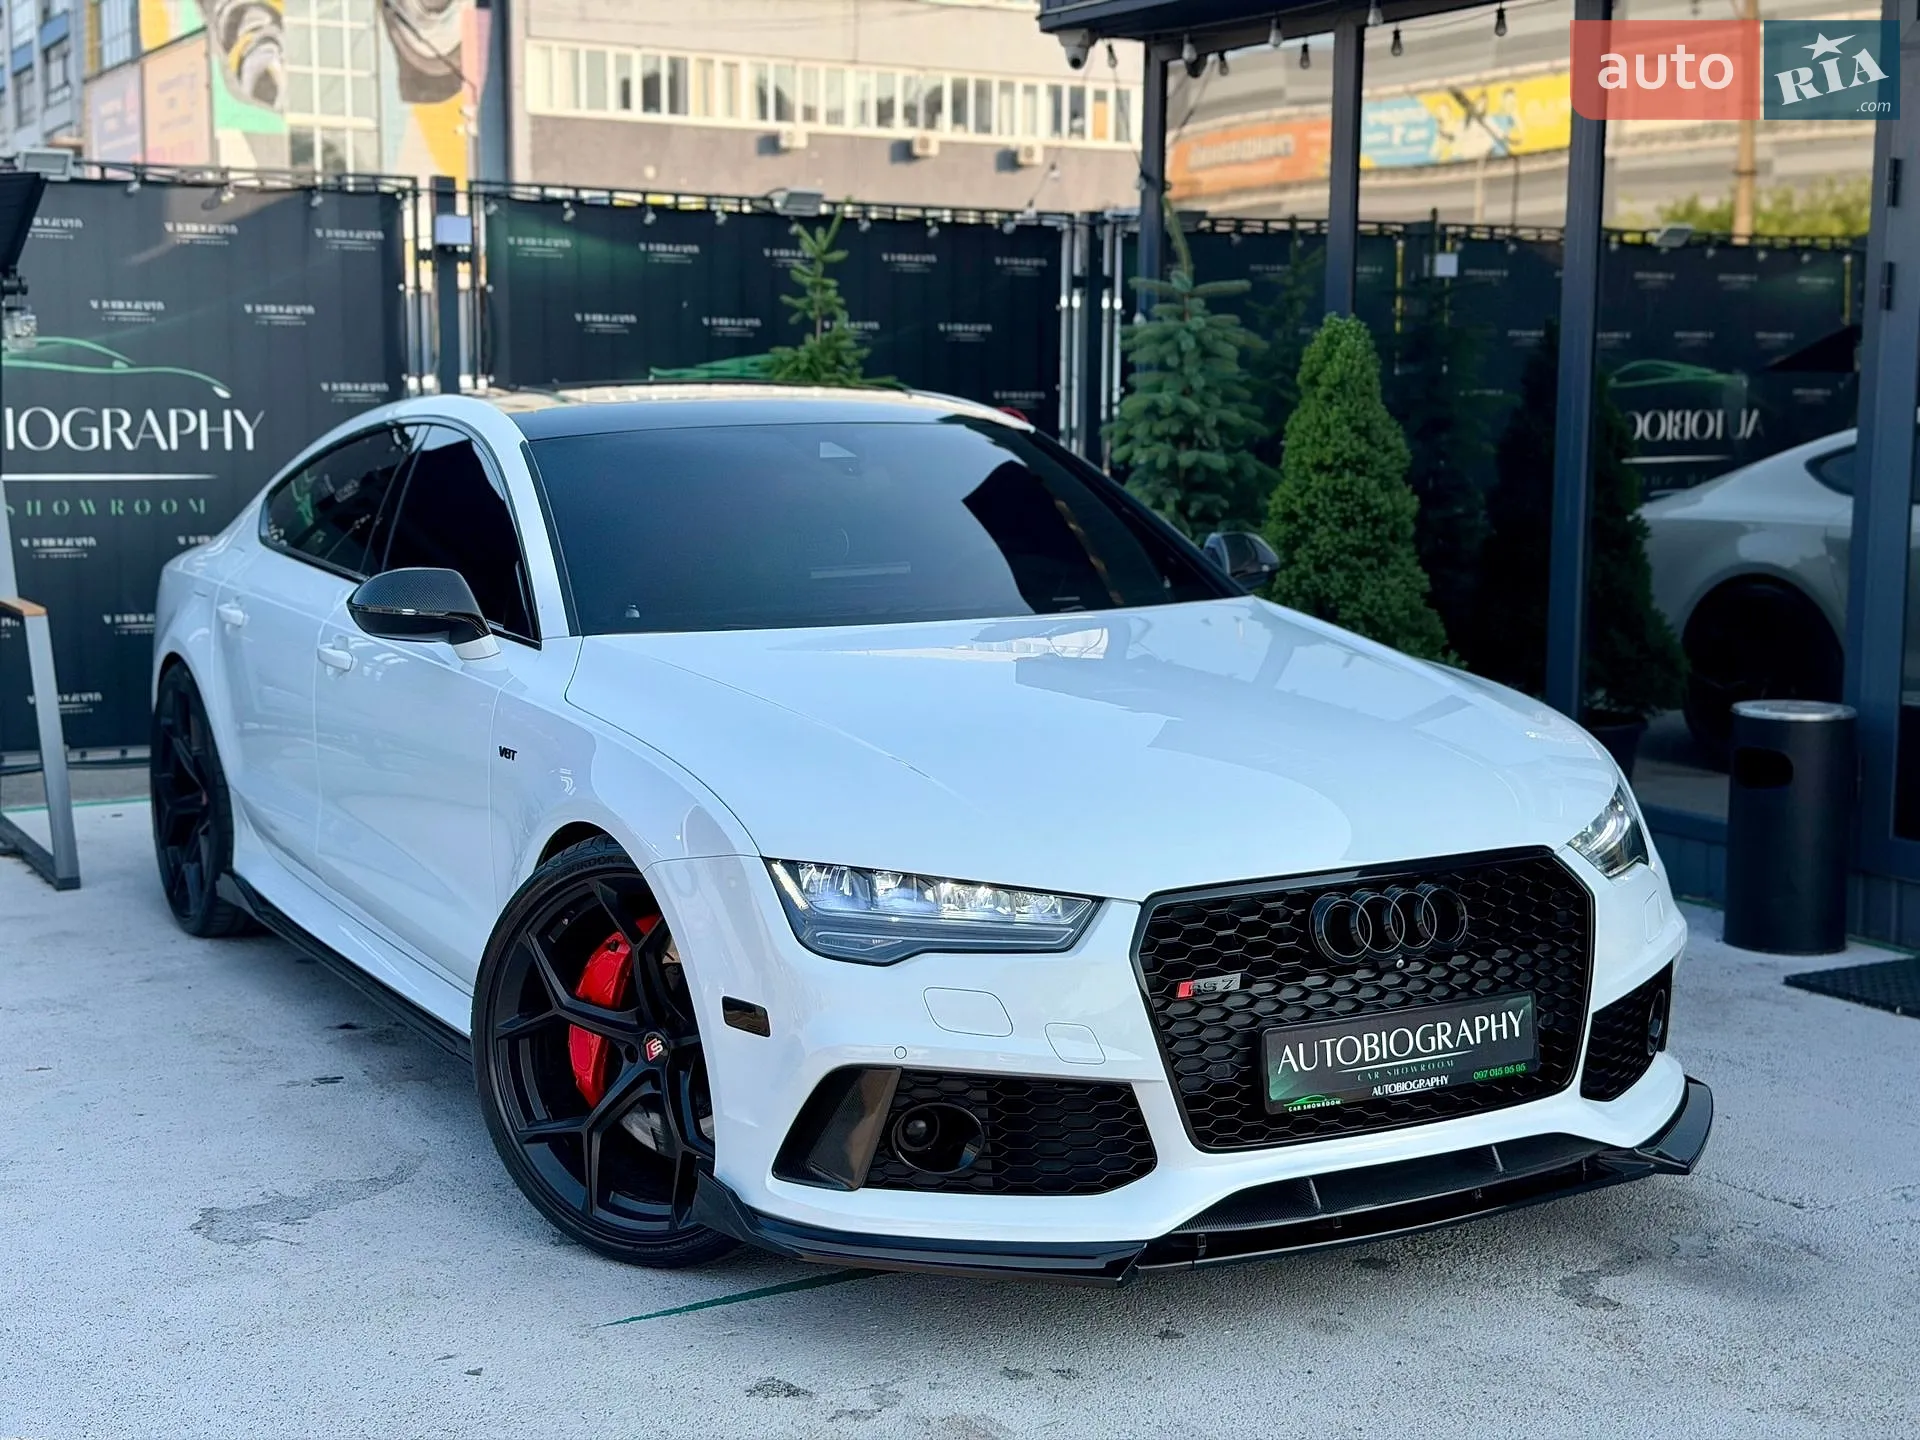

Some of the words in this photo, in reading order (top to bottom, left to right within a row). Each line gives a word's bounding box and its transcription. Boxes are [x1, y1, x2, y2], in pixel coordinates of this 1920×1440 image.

[1277, 1008, 1525, 1075] AUTOBIOGRAPHY
[1386, 1060, 1454, 1076] SHOWROOM
[1371, 1075, 1449, 1097] AUTOBIOGRAPHY
[1288, 1104, 1302, 1113] CAR
